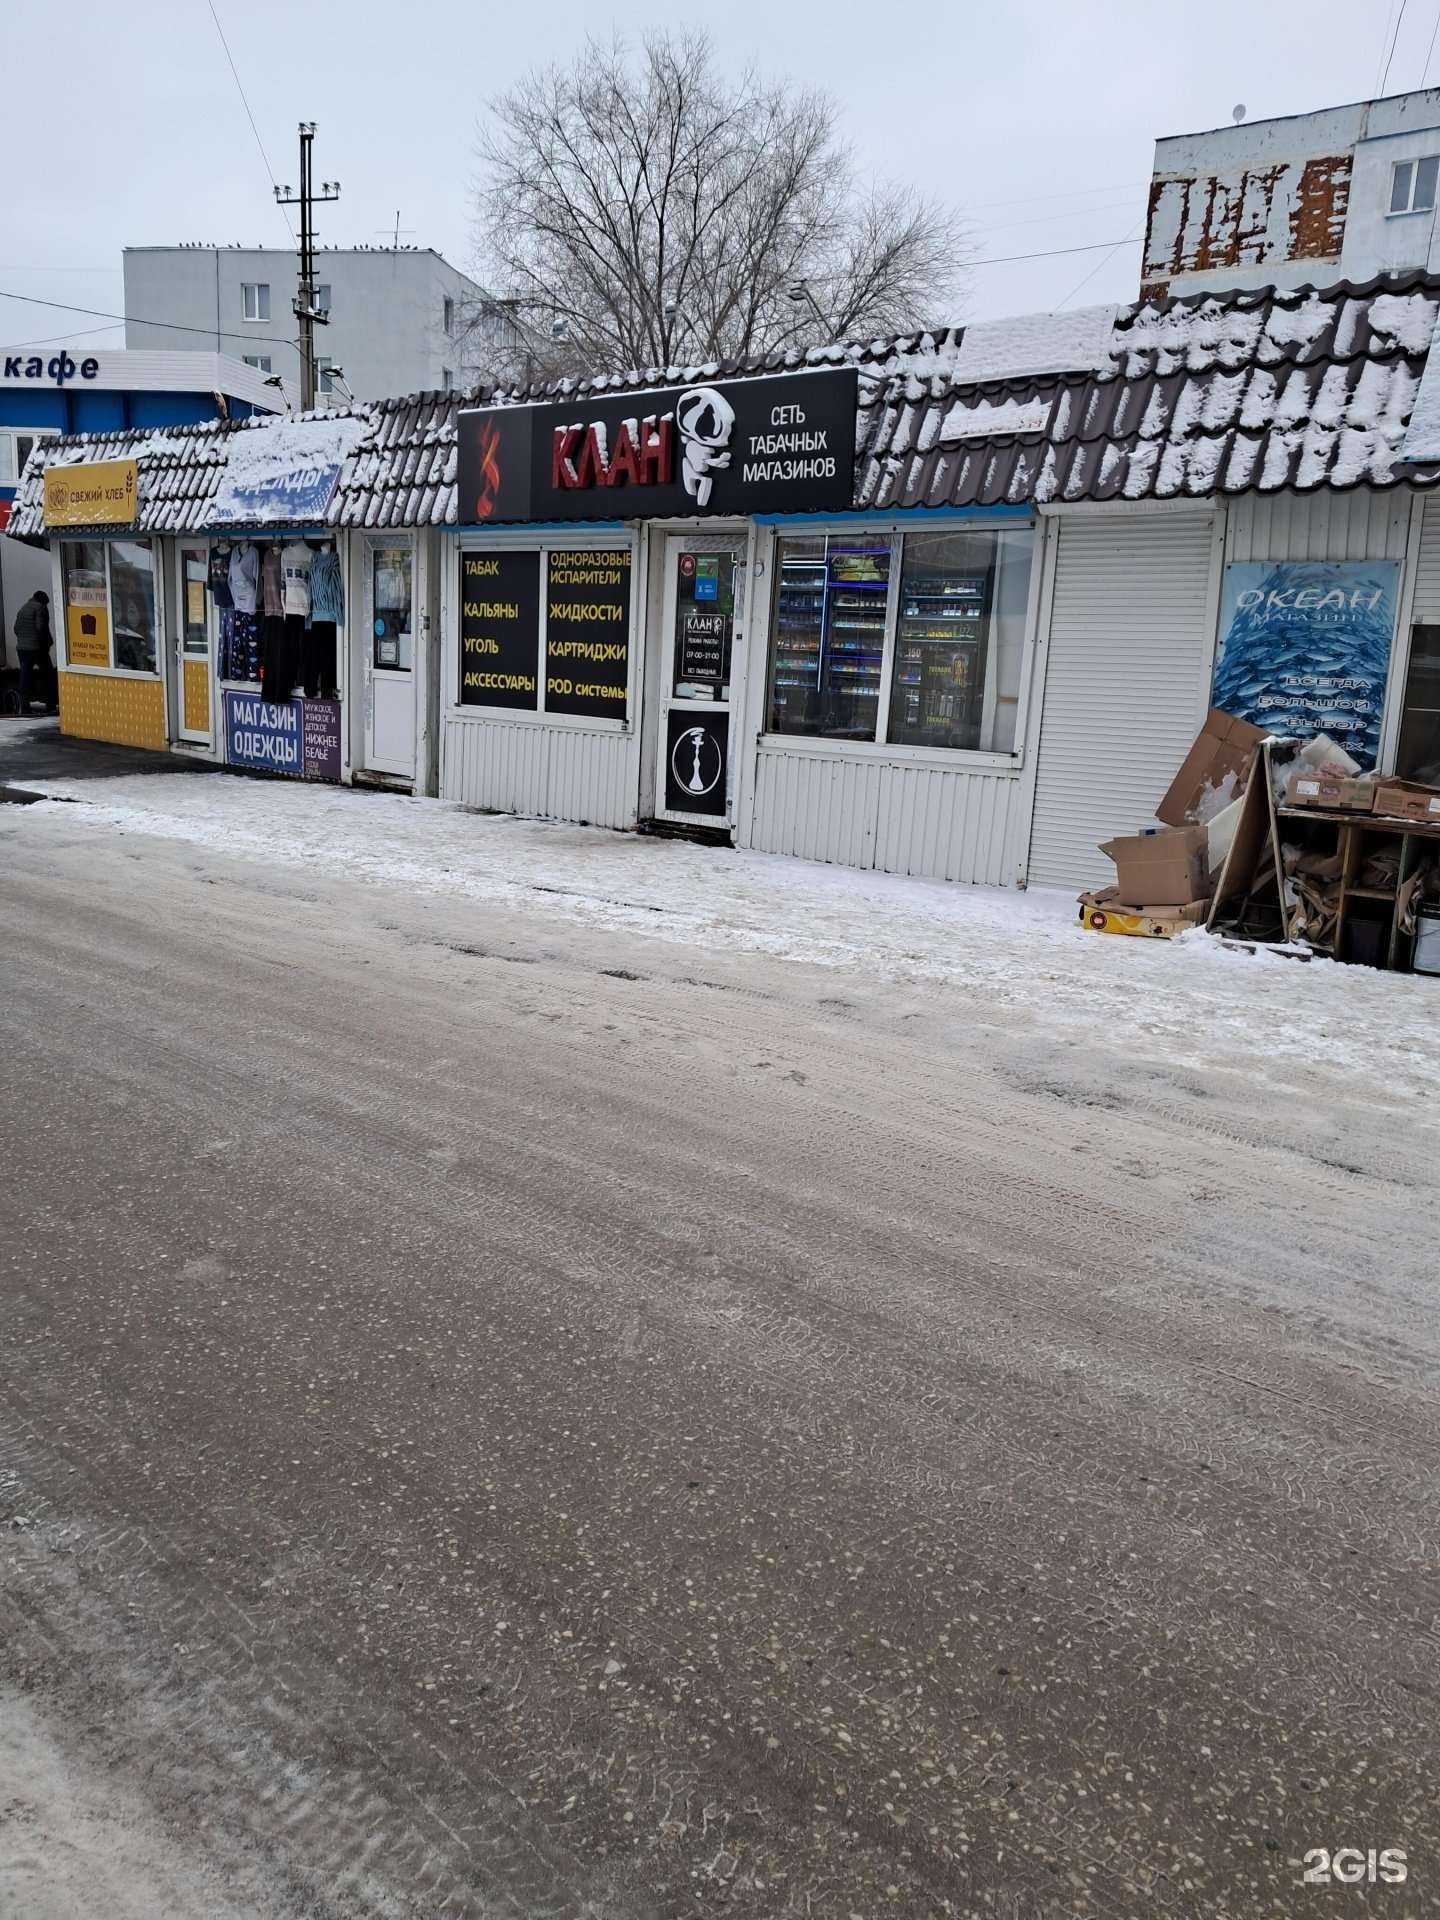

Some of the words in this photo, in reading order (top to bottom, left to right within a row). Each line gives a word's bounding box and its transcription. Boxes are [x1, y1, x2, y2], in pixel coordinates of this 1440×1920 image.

[4, 350, 99, 386] кафе
[770, 403, 805, 426] СЕТЬ
[552, 412, 674, 489] КЛАН
[749, 430, 827, 456] ТАБАЧНЫХ
[743, 456, 836, 482] МАГАЗИНОВ
[70, 486, 103, 503] СВЕЖИЙ
[105, 487, 124, 500] ХЛЕБ
[465, 560, 500, 576] ТАБАК
[550, 552, 632, 569] ОДНОРАЗОВЫЕ
[550, 570, 621, 585] ИСПАРИТЕЛИ
[1236, 588, 1384, 610] ОКЕАН
[464, 602, 519, 619] КАЛЬЯНЫ
[549, 603, 623, 622] ЖИДКОСТИ
[687, 617, 712, 630] КЛАН
[464, 638, 499, 654] УГОЛЬ
[548, 641, 627, 662] КАРТРИДЖИ
[464, 672, 535, 692] АКСЕССУАРЫ
[547, 678, 573, 695] POD
[1286, 676, 1372, 689] ВСЕГДА
[1258, 696, 1370, 710] БОЛЬШОЙ
[233, 700, 297, 731] МАГАЗИН
[1286, 718, 1368, 730] ВЫБОР
[234, 730, 298, 765] ОДЕЖДЫ
[305, 733, 338, 748] НИЖНЕЕ
